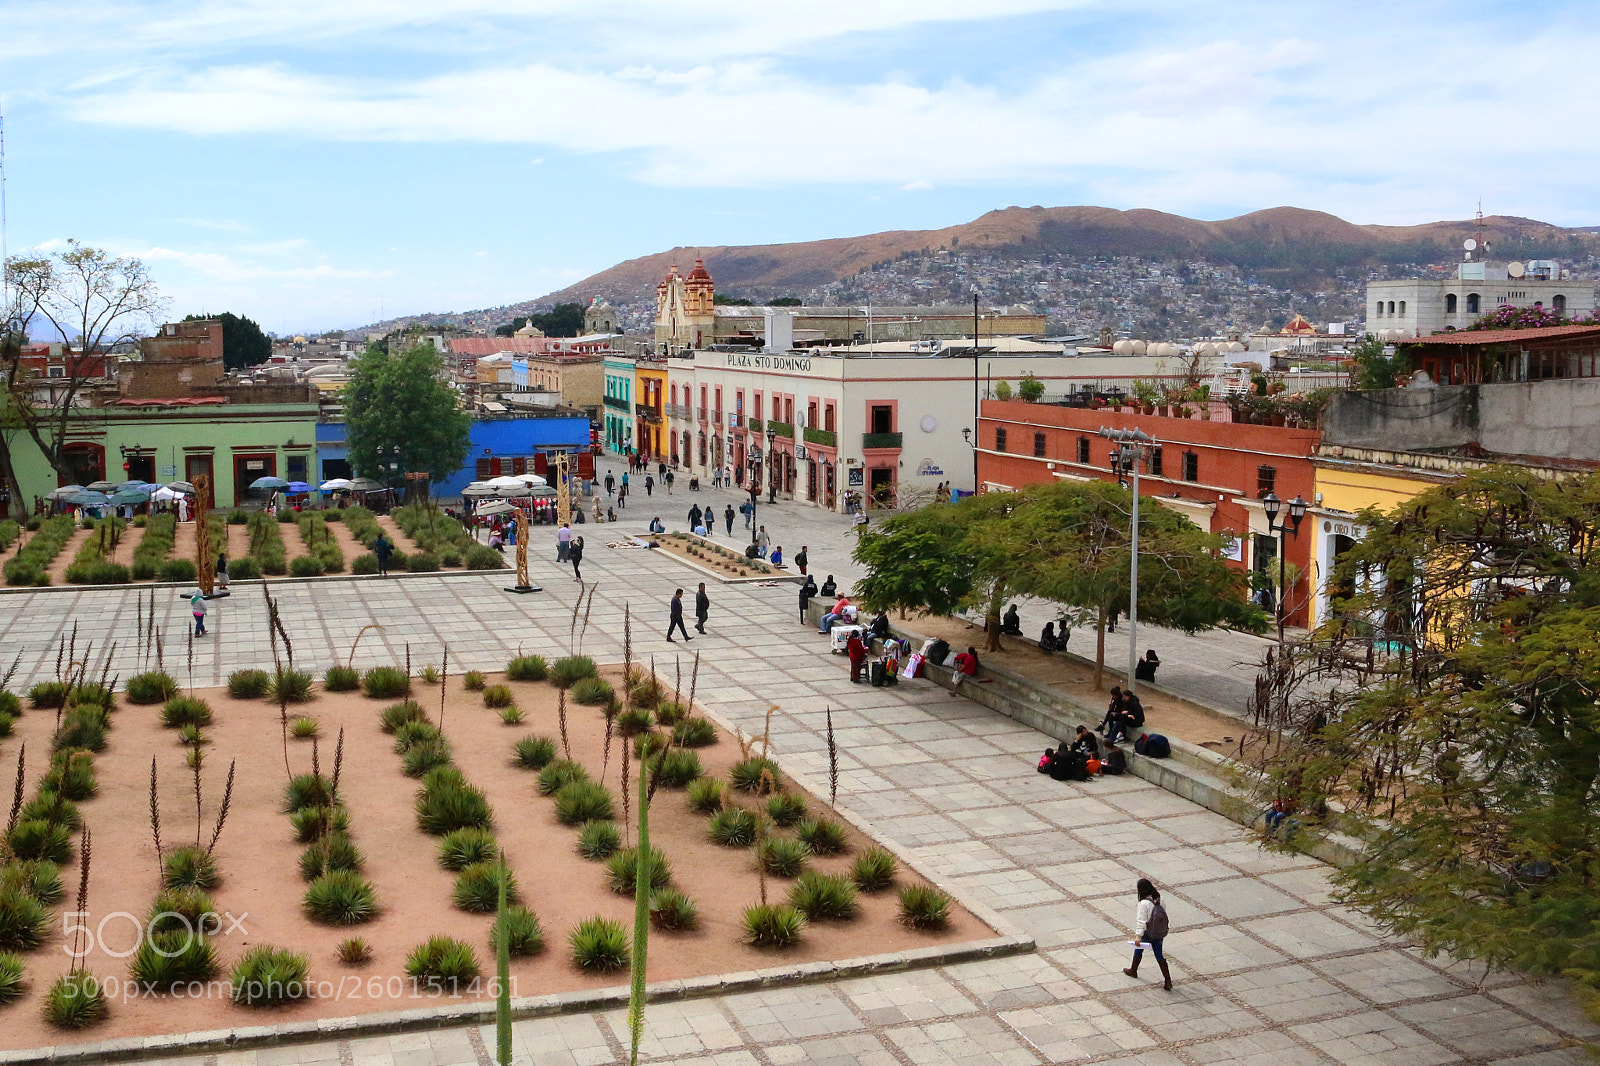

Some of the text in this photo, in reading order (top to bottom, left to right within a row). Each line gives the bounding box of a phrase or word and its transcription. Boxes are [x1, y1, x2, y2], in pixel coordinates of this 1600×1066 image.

[727, 354, 811, 371] PLAZA STO DOMINGO
[1334, 524, 1361, 537] ORO DE
